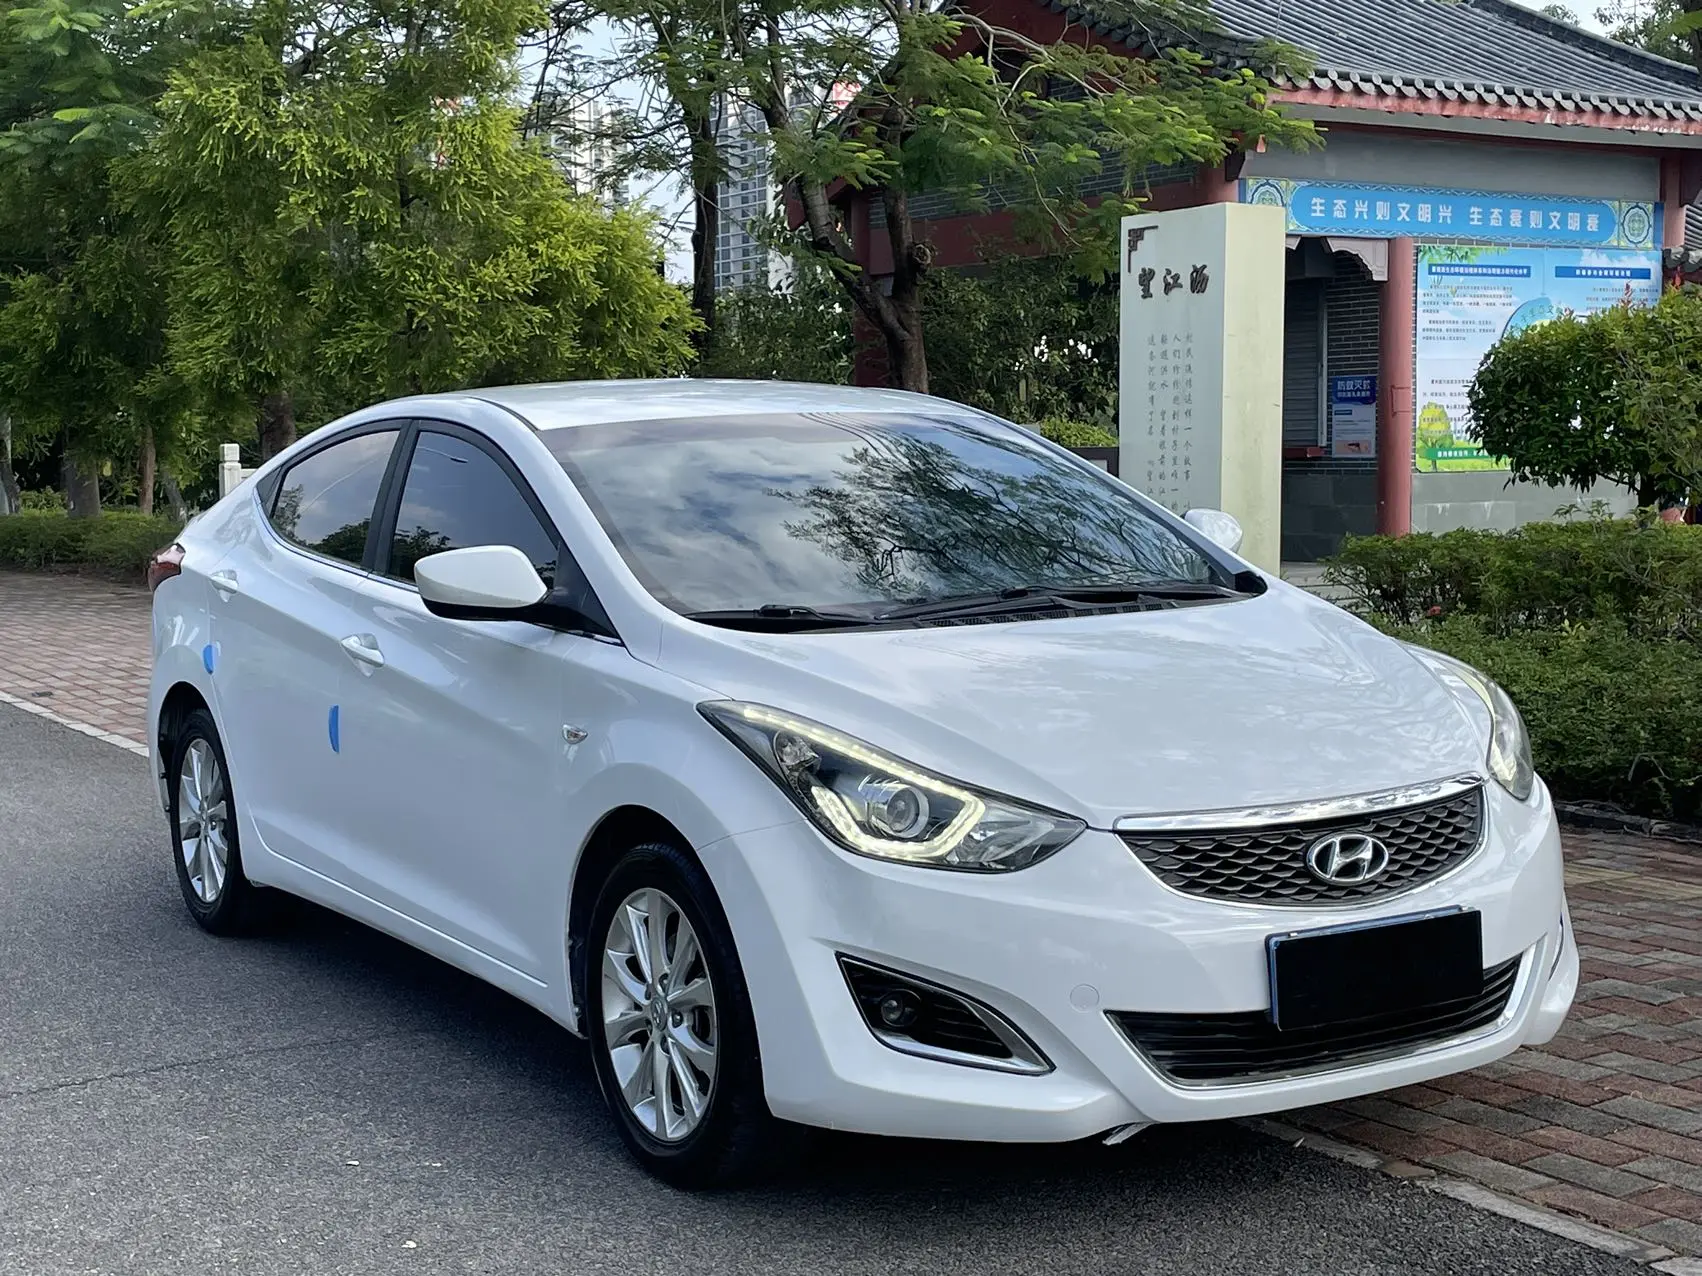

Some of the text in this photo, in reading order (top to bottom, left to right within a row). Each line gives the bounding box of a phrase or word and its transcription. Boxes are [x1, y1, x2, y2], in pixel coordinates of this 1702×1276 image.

[1310, 197, 1599, 232] 生态兴则文明兴 生态衰则文明衰
